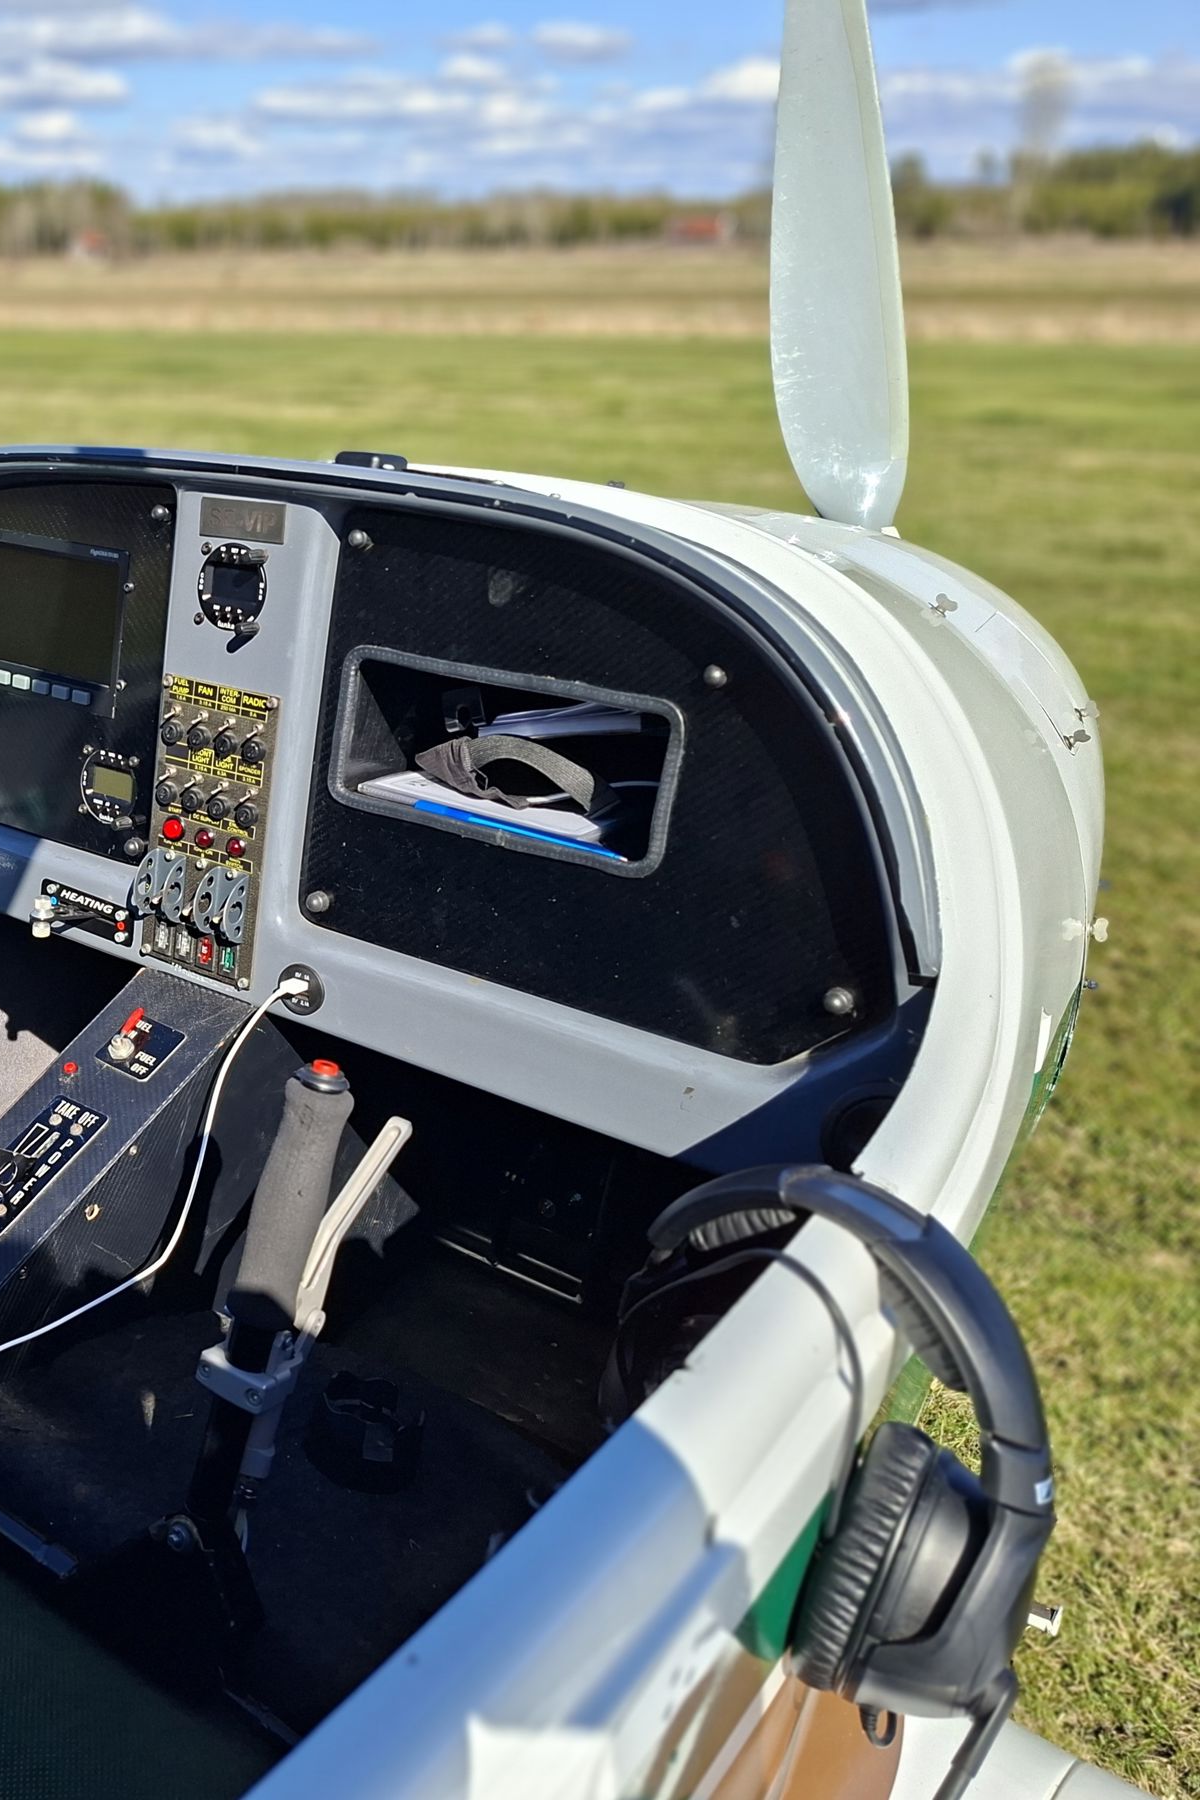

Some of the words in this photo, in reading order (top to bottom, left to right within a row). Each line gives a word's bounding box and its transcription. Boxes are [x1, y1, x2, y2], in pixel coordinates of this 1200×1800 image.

[174, 677, 189, 687] FUEL
[172, 685, 189, 694] PUMP
[198, 685, 213, 696] FAN
[220, 688, 240, 697] INTER-
[221, 695, 236, 704] COM
[192, 754, 210, 764] LIGHT
[216, 760, 233, 770] LIGHT
[60, 889, 114, 914] HEATING
[135, 1019, 152, 1032] UEL
[134, 1051, 157, 1066] FUEL
[130, 1063, 149, 1076] OFF
[54, 1100, 81, 1120] TAKE
[77, 1111, 99, 1128] OFF
[9, 1138, 74, 1205] POWER
